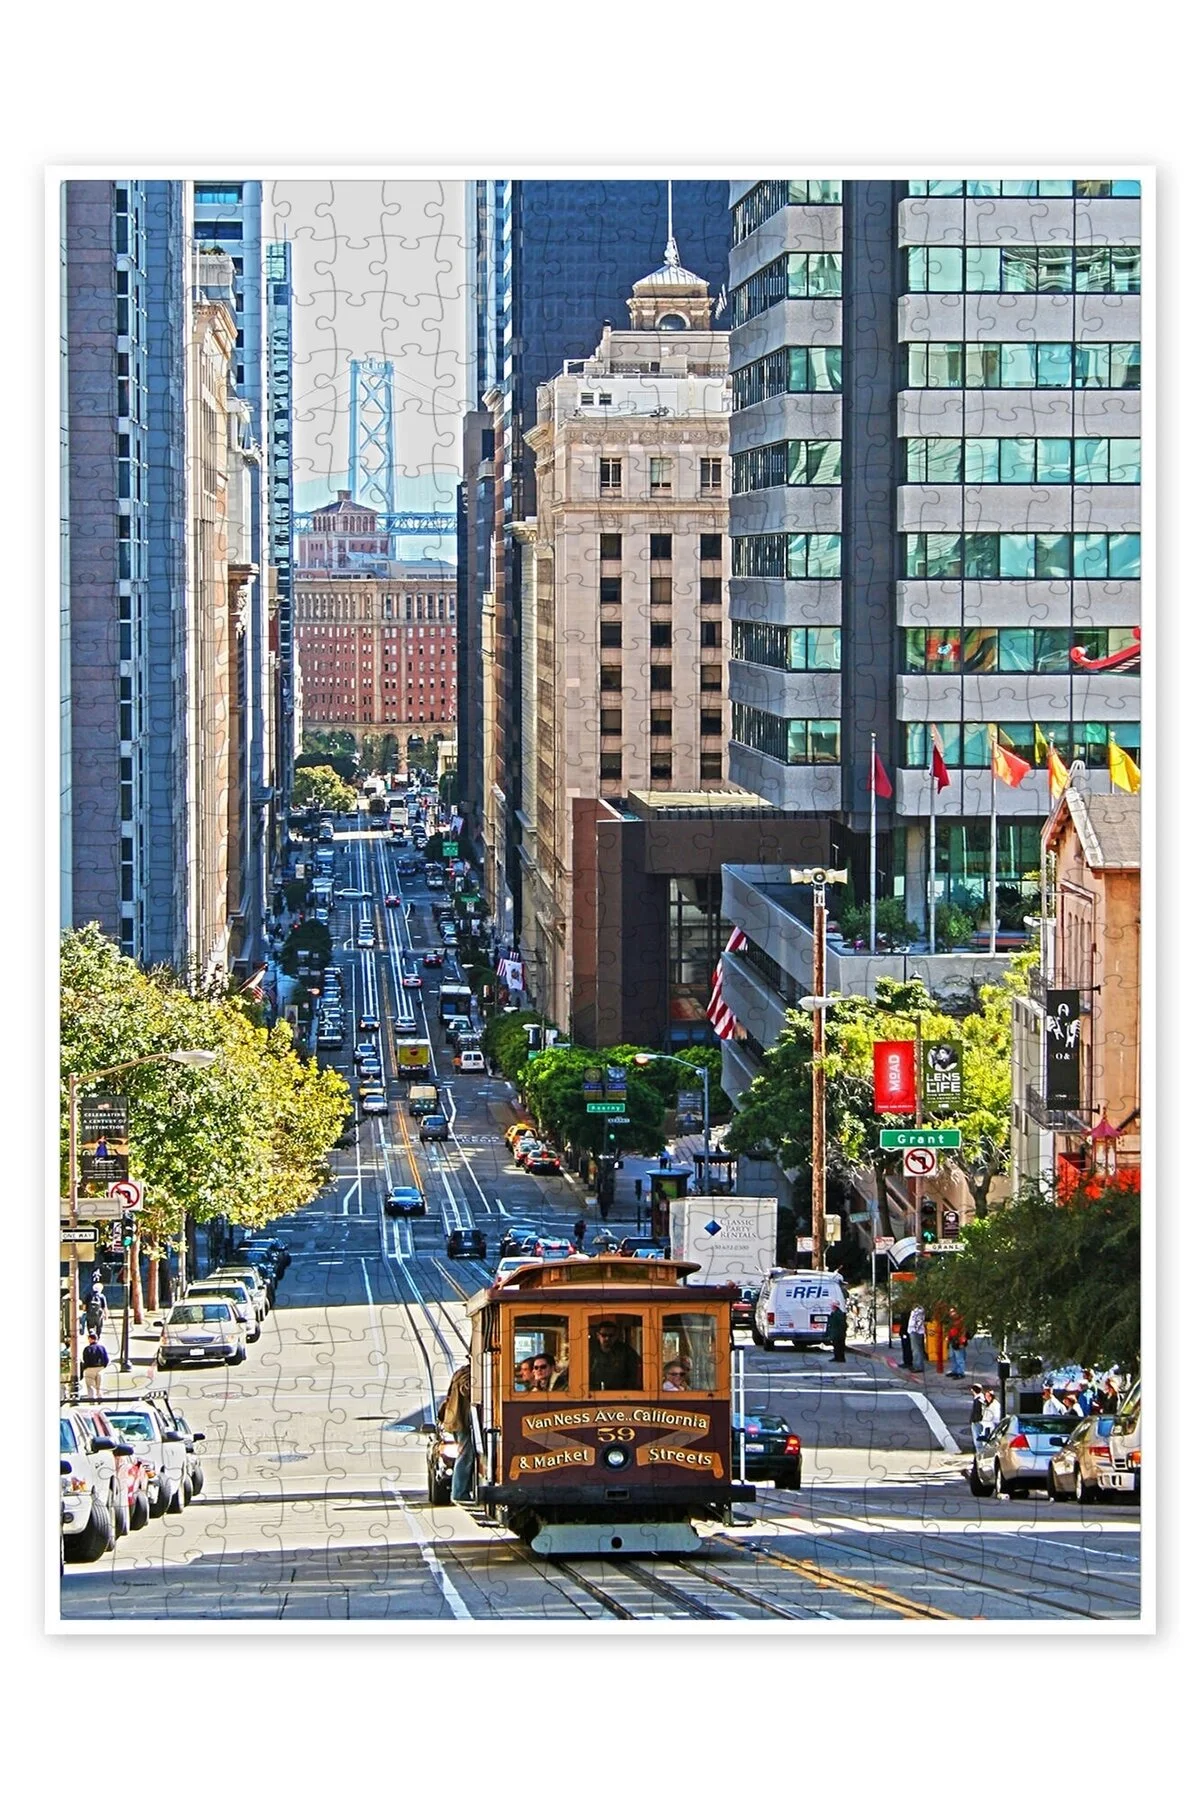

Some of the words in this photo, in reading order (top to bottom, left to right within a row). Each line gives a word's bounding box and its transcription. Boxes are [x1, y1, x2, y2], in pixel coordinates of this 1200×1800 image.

[926, 1072, 961, 1082] LENS
[926, 1081, 961, 1093] LIFE
[897, 1133, 945, 1145] Grant
[793, 1286, 822, 1299] RFI
[526, 1416, 552, 1429] Van
[553, 1413, 590, 1426] Ness
[633, 1409, 708, 1429] California
[597, 1426, 636, 1442] 59
[519, 1456, 531, 1469] &
[534, 1449, 589, 1469] Market
[649, 1448, 712, 1465] Streets
